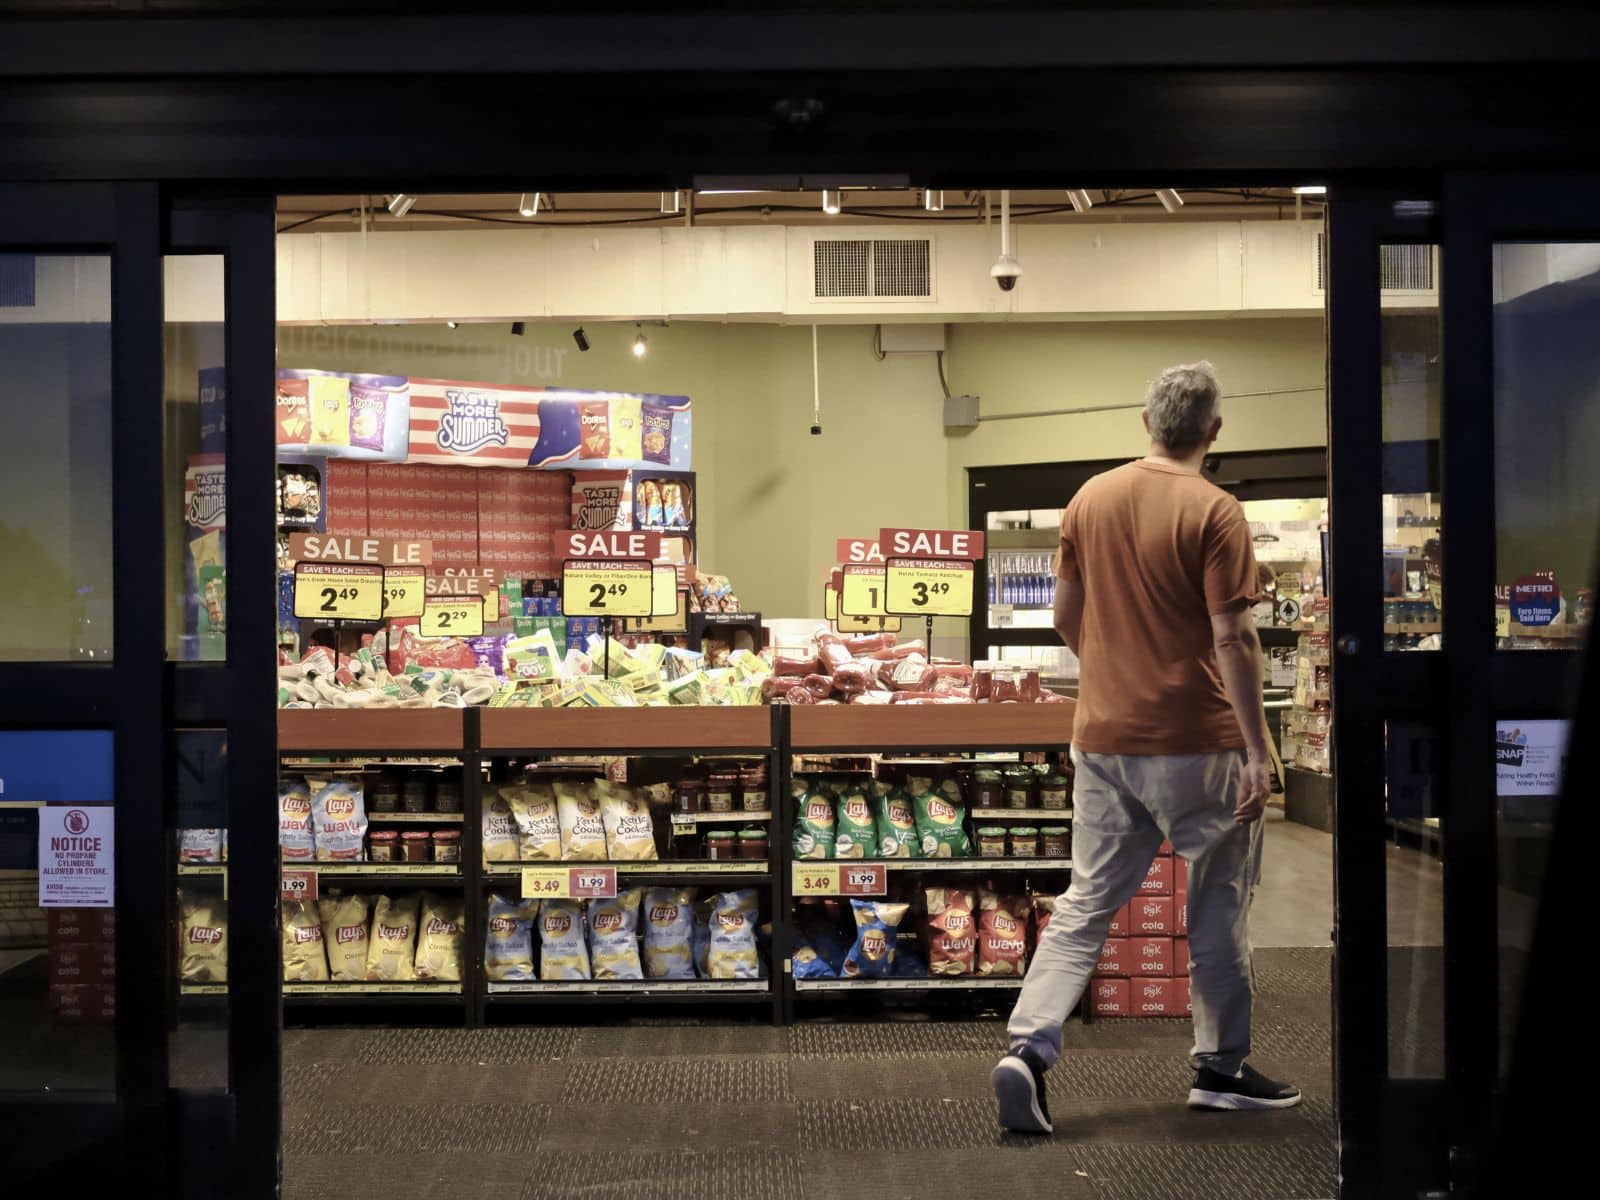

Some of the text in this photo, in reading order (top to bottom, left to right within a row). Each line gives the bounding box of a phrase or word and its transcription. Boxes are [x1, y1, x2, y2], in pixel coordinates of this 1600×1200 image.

[446, 391, 498, 406] TASTE
[452, 405, 496, 417] MORE
[438, 413, 508, 450] SUMMER
[584, 488, 619, 498] TASTE
[588, 498, 616, 507] MORE
[189, 494, 226, 526] SUMME
[303, 536, 380, 561] SALE
[570, 533, 646, 556] SALE
[894, 531, 969, 556] SALE
[392, 543, 421, 563] LE
[850, 541, 885, 562] SA
[602, 562, 622, 570] EACH
[426, 579, 479, 594] SALE
[1516, 585, 1552, 593] METRO
[1496, 748, 1524, 760] SNAP
[51, 837, 102, 852] NOTICE
[580, 878, 604, 887] 1.99
[803, 878, 830, 889] 3.49
[851, 875, 874, 884] 1.99
[1141, 880, 1163, 889] cola
[282, 881, 305, 891] 1.99
[533, 880, 560, 892] 3.49
[102, 927, 115, 935] co
[1142, 922, 1164, 930] cola
[941, 938, 975, 953] wavy
[989, 939, 1025, 954] wavy
[1098, 962, 1119, 971] cola
[1141, 962, 1164, 970] cola
[1097, 1002, 1119, 1011] cola
[1142, 1002, 1165, 1011] cola
